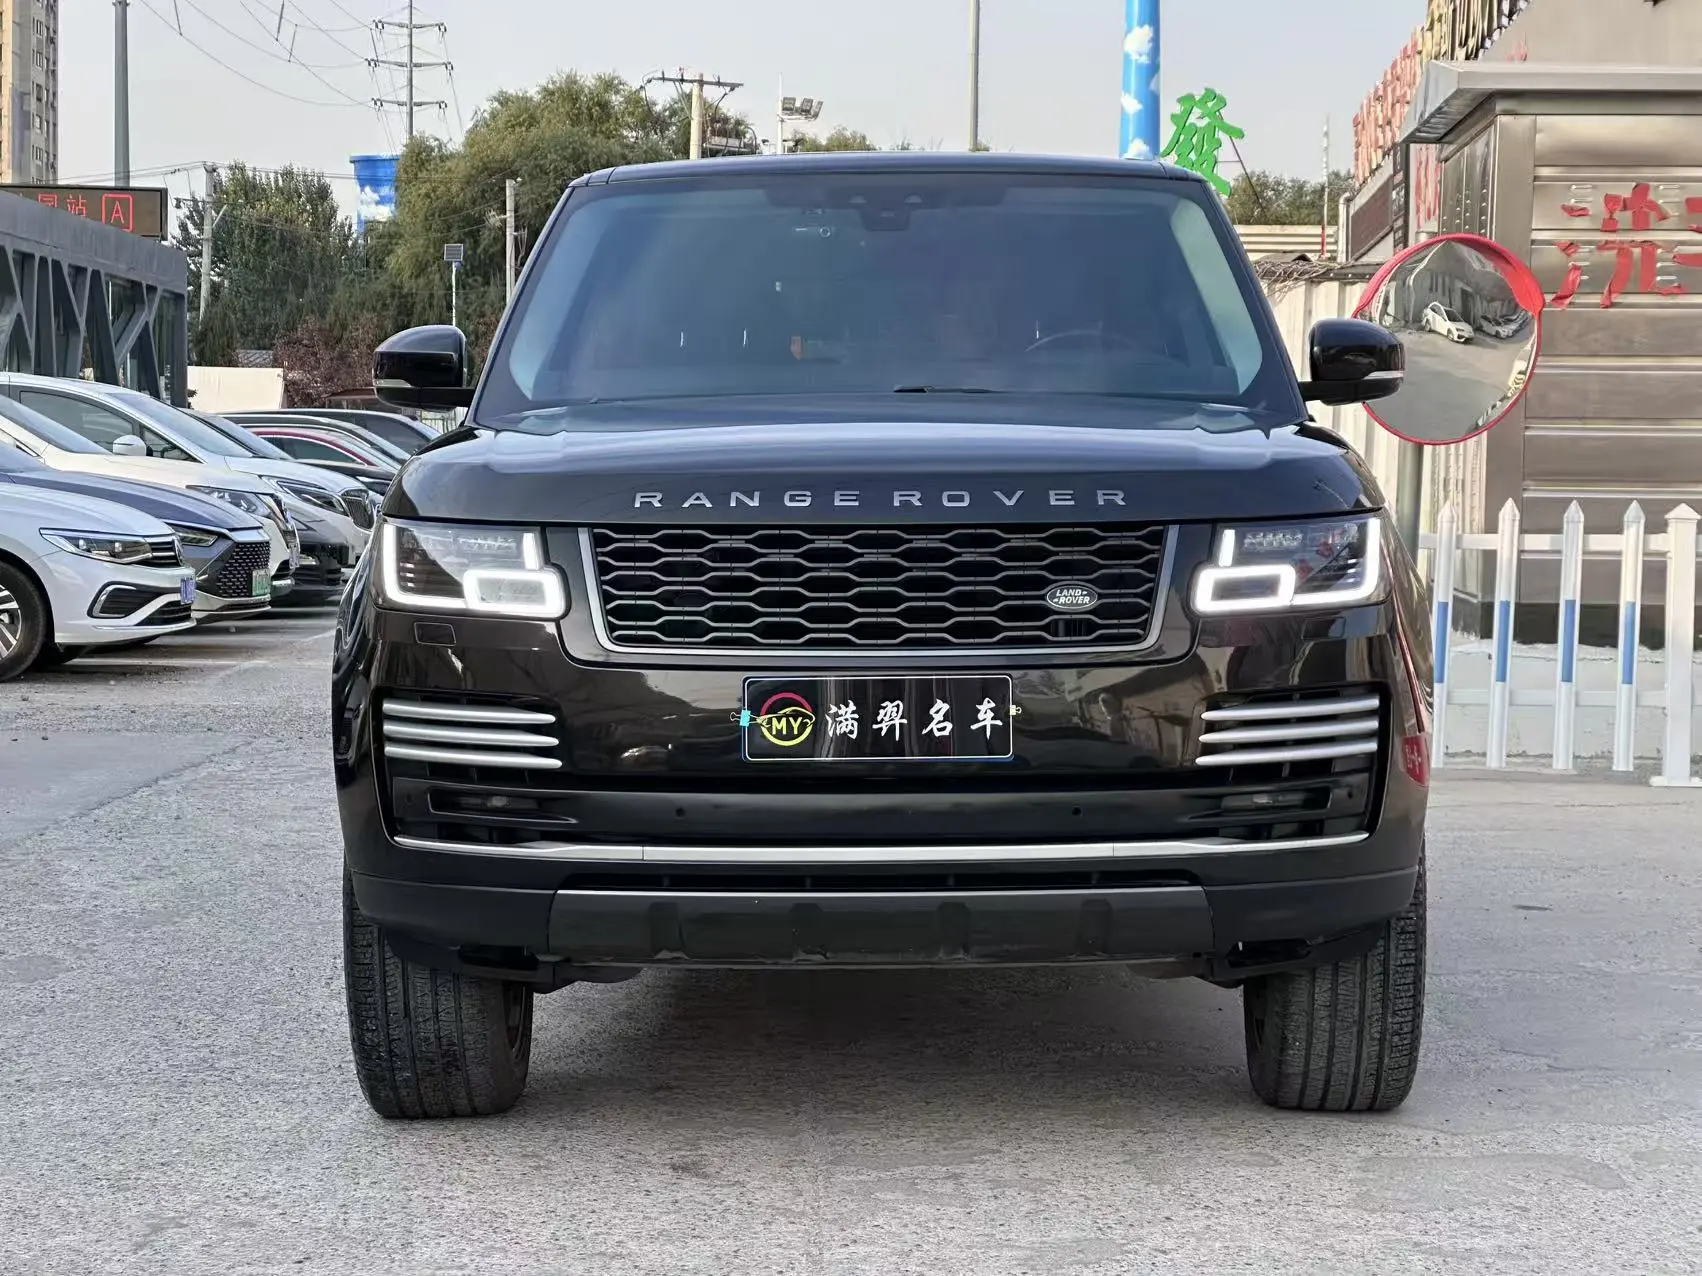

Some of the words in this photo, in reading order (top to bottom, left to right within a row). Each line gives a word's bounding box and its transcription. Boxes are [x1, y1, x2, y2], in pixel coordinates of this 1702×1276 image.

[110, 200, 125, 224] A
[1552, 183, 1702, 310] 洗
[634, 490, 860, 508] RANGE
[893, 489, 1127, 507] ROVER
[1055, 588, 1082, 597] LAND
[1058, 596, 1091, 604] ROVER
[771, 716, 802, 736] MY
[825, 697, 1003, 742] 满羿名车
